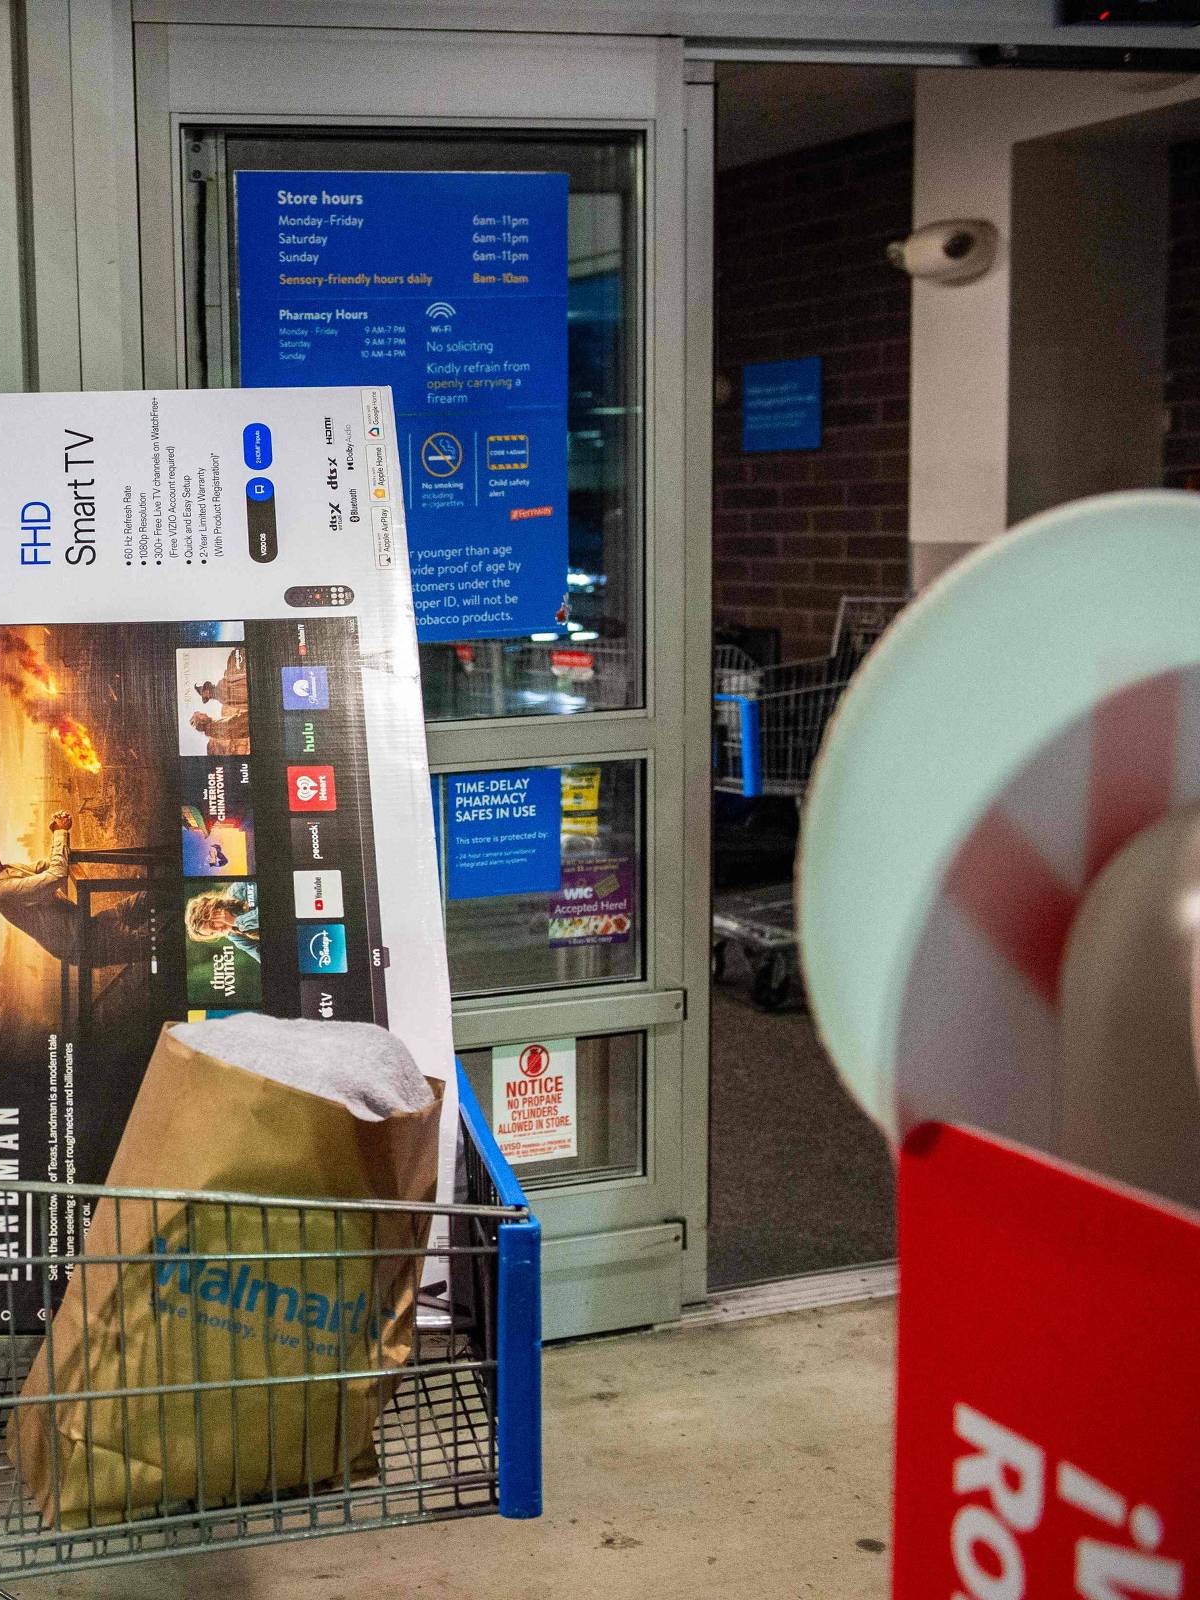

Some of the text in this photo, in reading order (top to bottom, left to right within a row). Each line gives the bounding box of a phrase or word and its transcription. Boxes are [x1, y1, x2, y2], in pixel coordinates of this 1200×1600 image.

[278, 191, 363, 205] Store hours
[278, 215, 528, 228] Monday-Friday 6am-11pm
[278, 233, 528, 246] Saturday 6am-11pm
[279, 251, 528, 264] Sunday 6am-11pm
[279, 273, 528, 286] Sensory-friendly hours daily 8am-10am
[279, 309, 368, 322] Pharmacy Hours
[427, 340, 493, 353] No soliciting
[427, 361, 530, 374] Kindly refrain from
[427, 377, 512, 390] openly carrying
[427, 393, 468, 404] firearm
[324, 417, 332, 445] HDMI
[345, 444, 355, 462] Dolby
[375, 447, 385, 486] Apple Home
[151, 397, 163, 558] 300+ Free Live TV channels on WatchFree+
[422, 481, 464, 490] No smoking
[489, 478, 530, 488] Child safety
[64, 429, 96, 566] Smart TV
[166, 446, 179, 558] (Free VIZIO Account required)
[349, 488, 358, 515] Bluetooth
[489, 489, 504, 498] alert
[182, 475, 194, 558] Quick and Easy Setup
[198, 467, 208, 558] 2-Year Limited Warranty
[213, 504, 222, 534] Product
[123, 486, 133, 559] 60 Hz Refresh Rate
[139, 492, 149, 559] 1080p Resolution
[381, 509, 390, 552] Apple AirPlay
[21, 501, 51, 565] FHD
[214, 536, 224, 557] (With
[418, 544, 512, 560] younger than age
[437, 560, 521, 577] proof of age by
[458, 578, 510, 590] under the
[444, 594, 518, 608] ID, will not be
[415, 610, 513, 627] tobacco products.
[303, 722, 316, 752] hulu
[240, 764, 249, 784] hulu
[208, 773, 217, 815] INTERIOR
[216, 767, 226, 820] CHINATOWN
[319, 775, 327, 800] iHeart
[456, 778, 530, 794] TIME-DELAY
[456, 793, 526, 808] PHARMACY
[456, 805, 536, 822] SAFES IN USE
[310, 825, 323, 859] peacock
[456, 836, 470, 845] This
[472, 835, 491, 844] store
[500, 832, 536, 845] protected
[247, 884, 255, 907] STARZ
[314, 877, 322, 899] YouTube
[563, 887, 593, 899] WIC
[555, 899, 626, 915] Accepted Here!
[318, 930, 332, 968] Disney+
[373, 948, 381, 966] onn
[210, 954, 225, 990] three
[221, 946, 236, 996] women
[320, 992, 333, 1006] tv
[506, 1076, 564, 1098] NOTICE
[508, 1093, 562, 1110] NO PROPANE
[512, 1106, 558, 1120] CYLINDERS
[498, 1120, 533, 1135] ALLOWED
[536, 1119, 543, 1129] IN
[546, 1116, 572, 1128] STORE.
[64, 1043, 76, 1234] seeking roughnecks and billionaires
[48, 1034, 58, 1280] Set the boomtow of Texas, Landman modern tale
[155, 1236, 366, 1334] Walmart
[951, 1401, 1046, 1600] Ro
